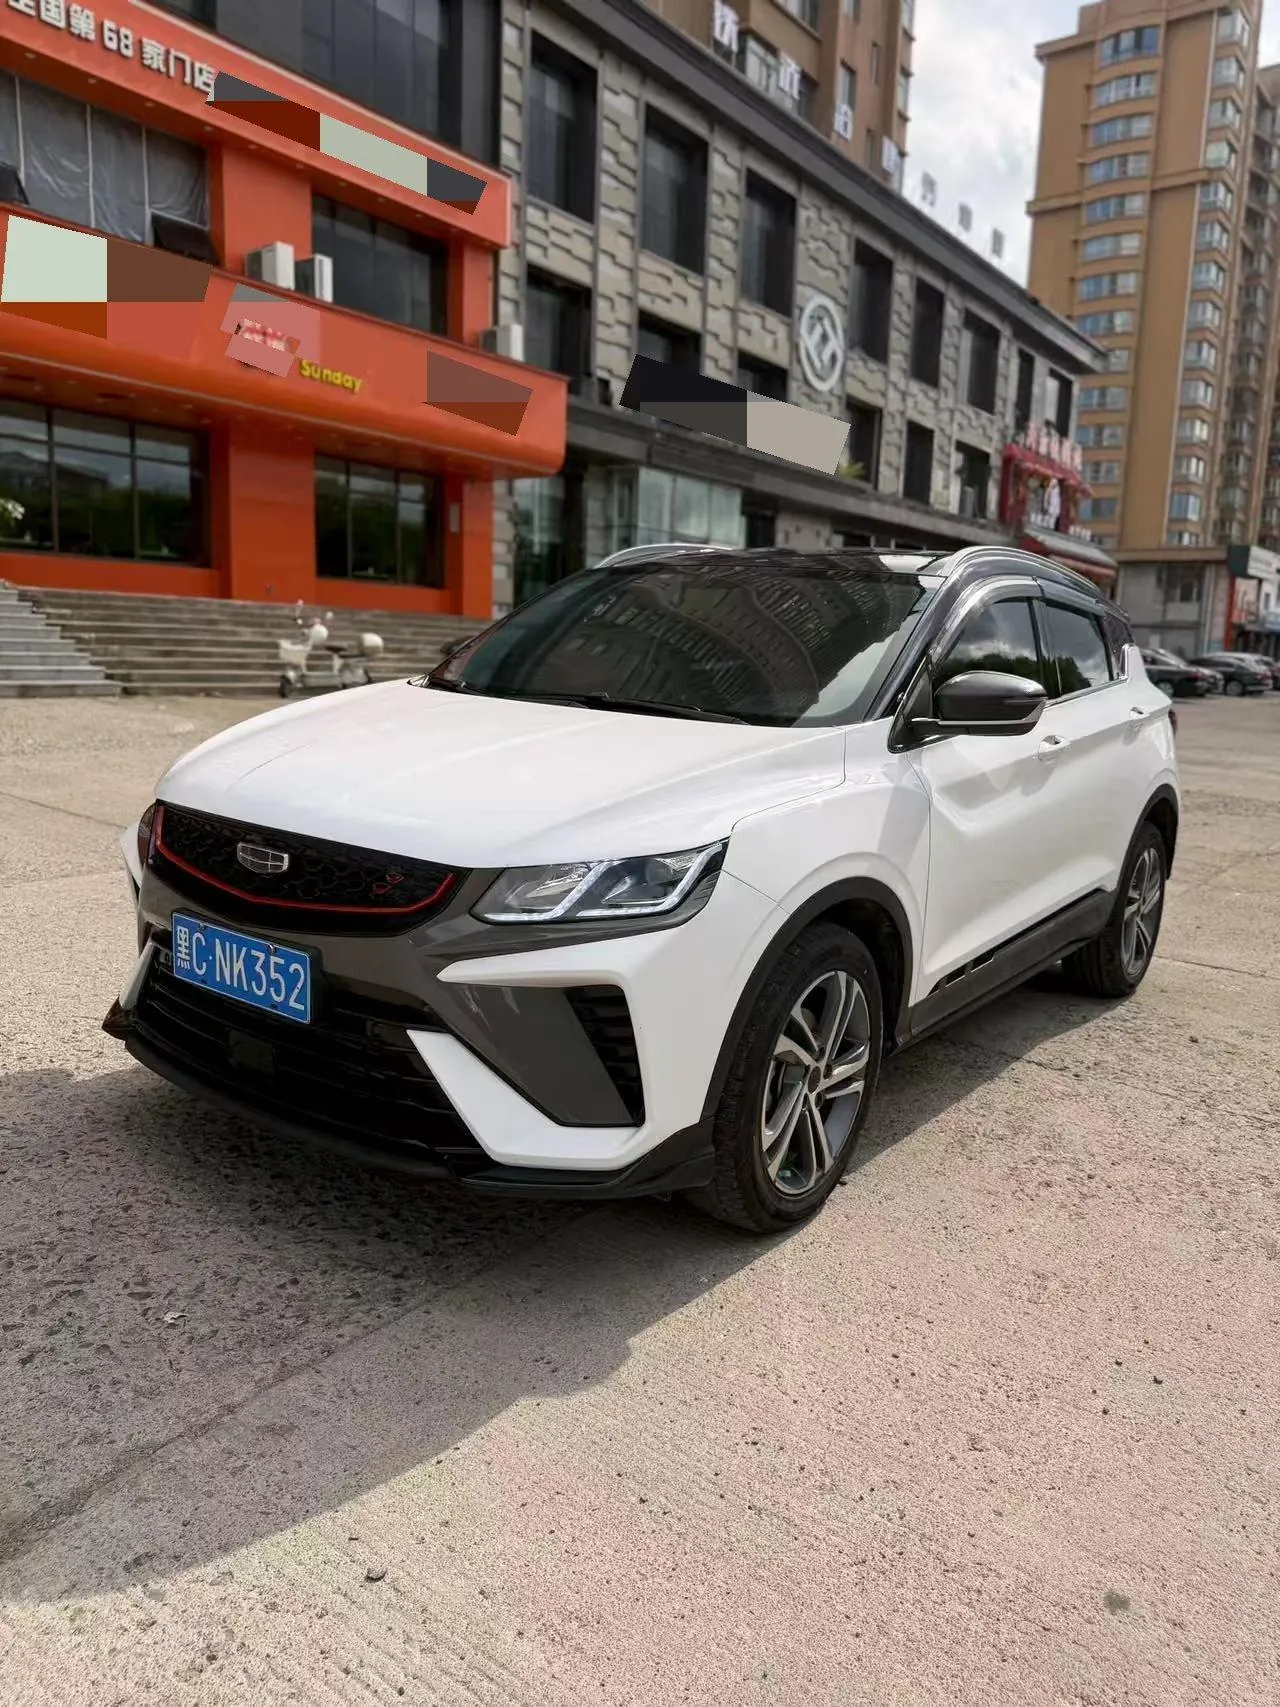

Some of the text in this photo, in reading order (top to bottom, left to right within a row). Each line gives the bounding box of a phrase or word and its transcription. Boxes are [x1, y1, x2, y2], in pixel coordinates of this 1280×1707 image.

[103, 19, 134, 58] 68
[142, 36, 215, 97] 家门店
[300, 359, 363, 393] Sunday
